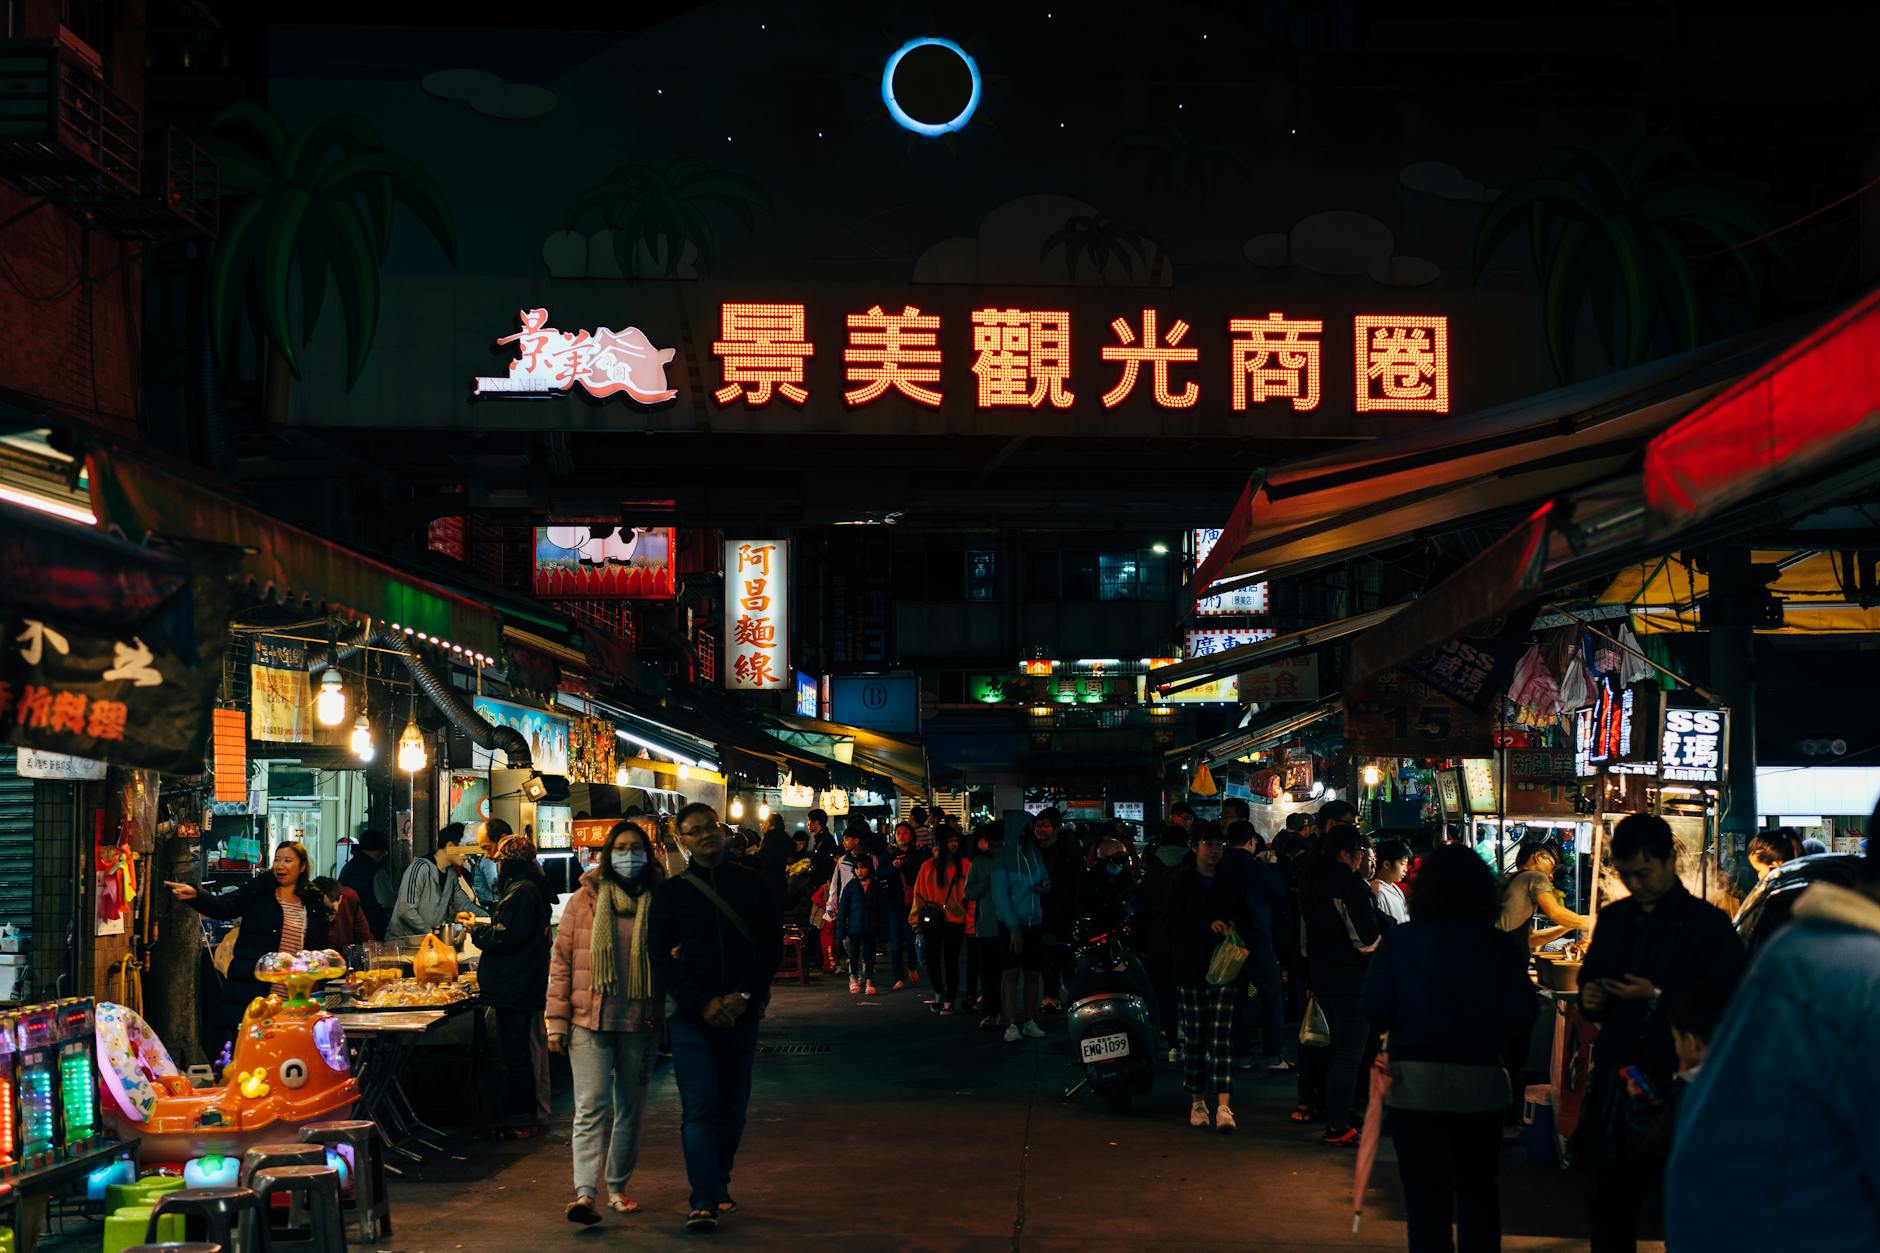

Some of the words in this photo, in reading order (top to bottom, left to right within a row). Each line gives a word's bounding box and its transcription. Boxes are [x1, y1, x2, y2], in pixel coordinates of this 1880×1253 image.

[496, 308, 594, 391] 景美
[713, 302, 1450, 414] 景美觀光商圈
[733, 543, 781, 687] 阿昌麵線
[1191, 634, 1269, 658] 廣東
